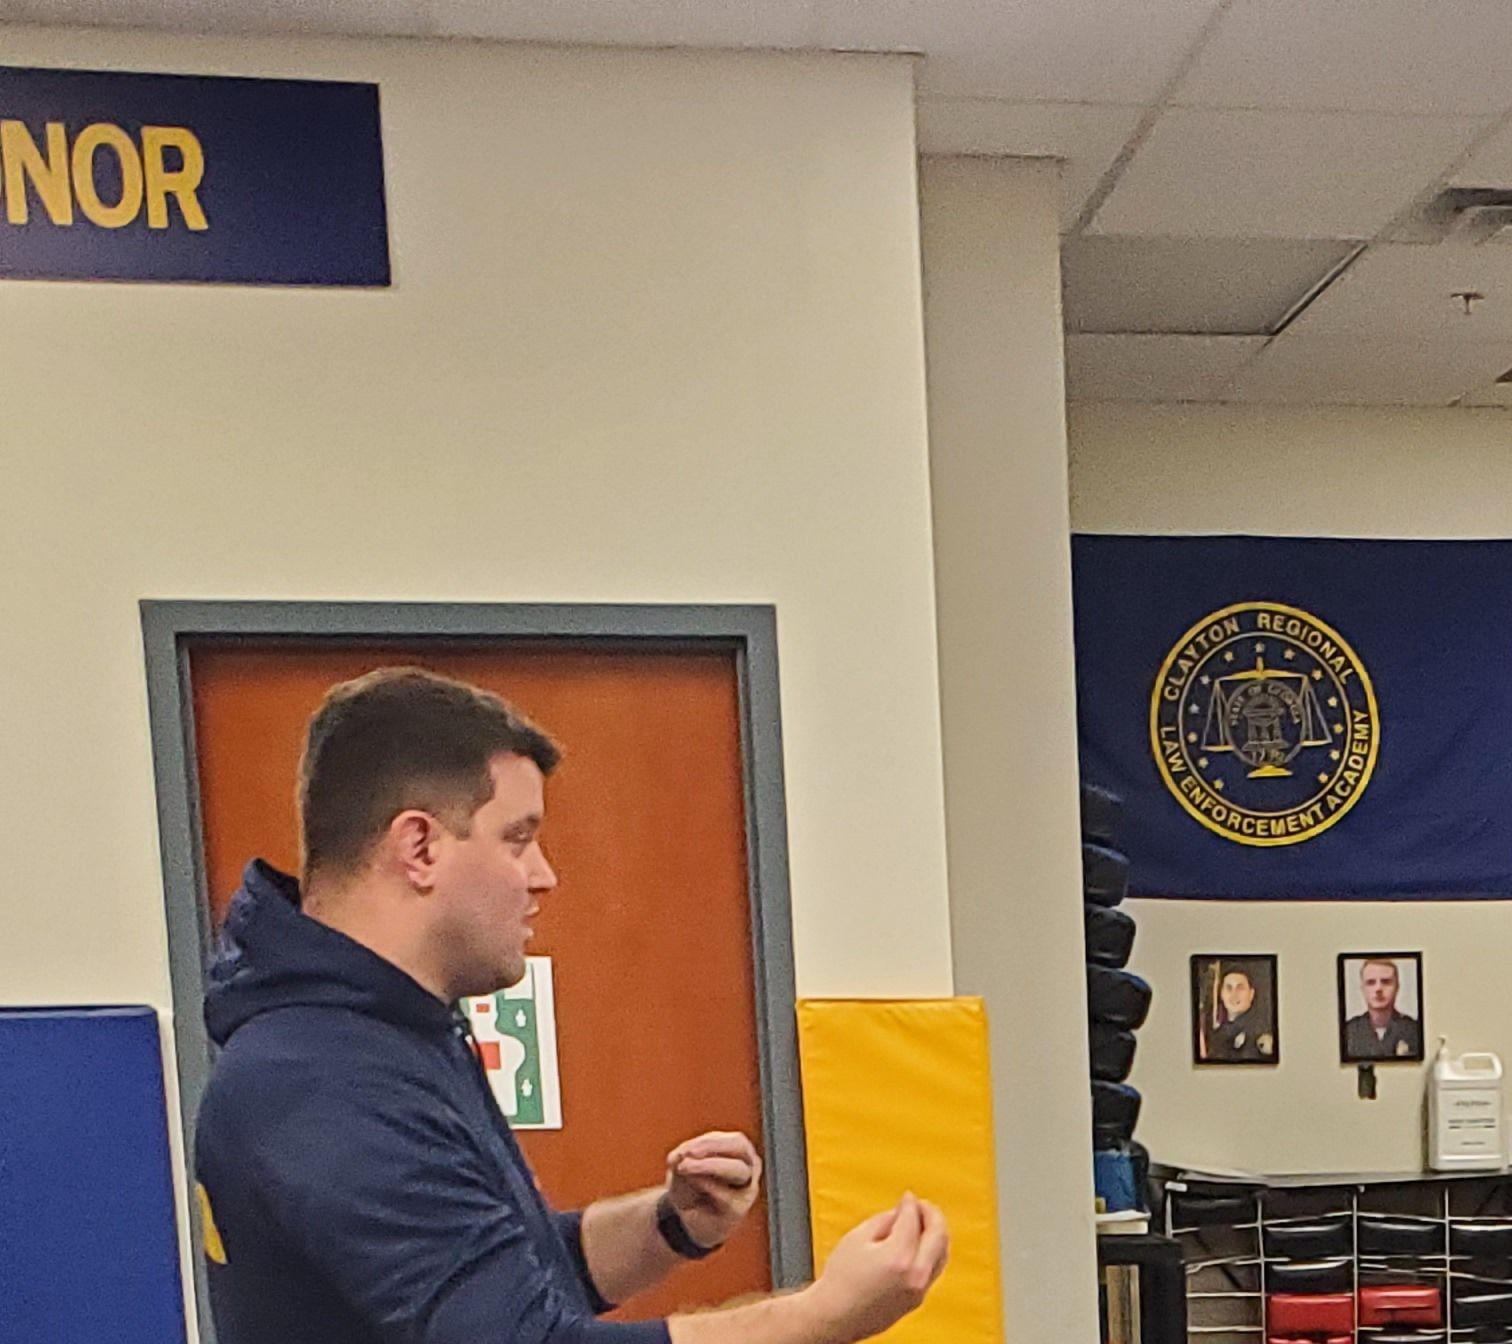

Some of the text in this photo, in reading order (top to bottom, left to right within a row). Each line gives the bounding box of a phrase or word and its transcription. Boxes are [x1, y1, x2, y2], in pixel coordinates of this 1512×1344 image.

[0, 120, 208, 230] NOR
[1163, 611, 1354, 701] CLAYTON REGIONAL
[1160, 709, 1370, 836] LAW ENFORCEMENT ACADEMY
